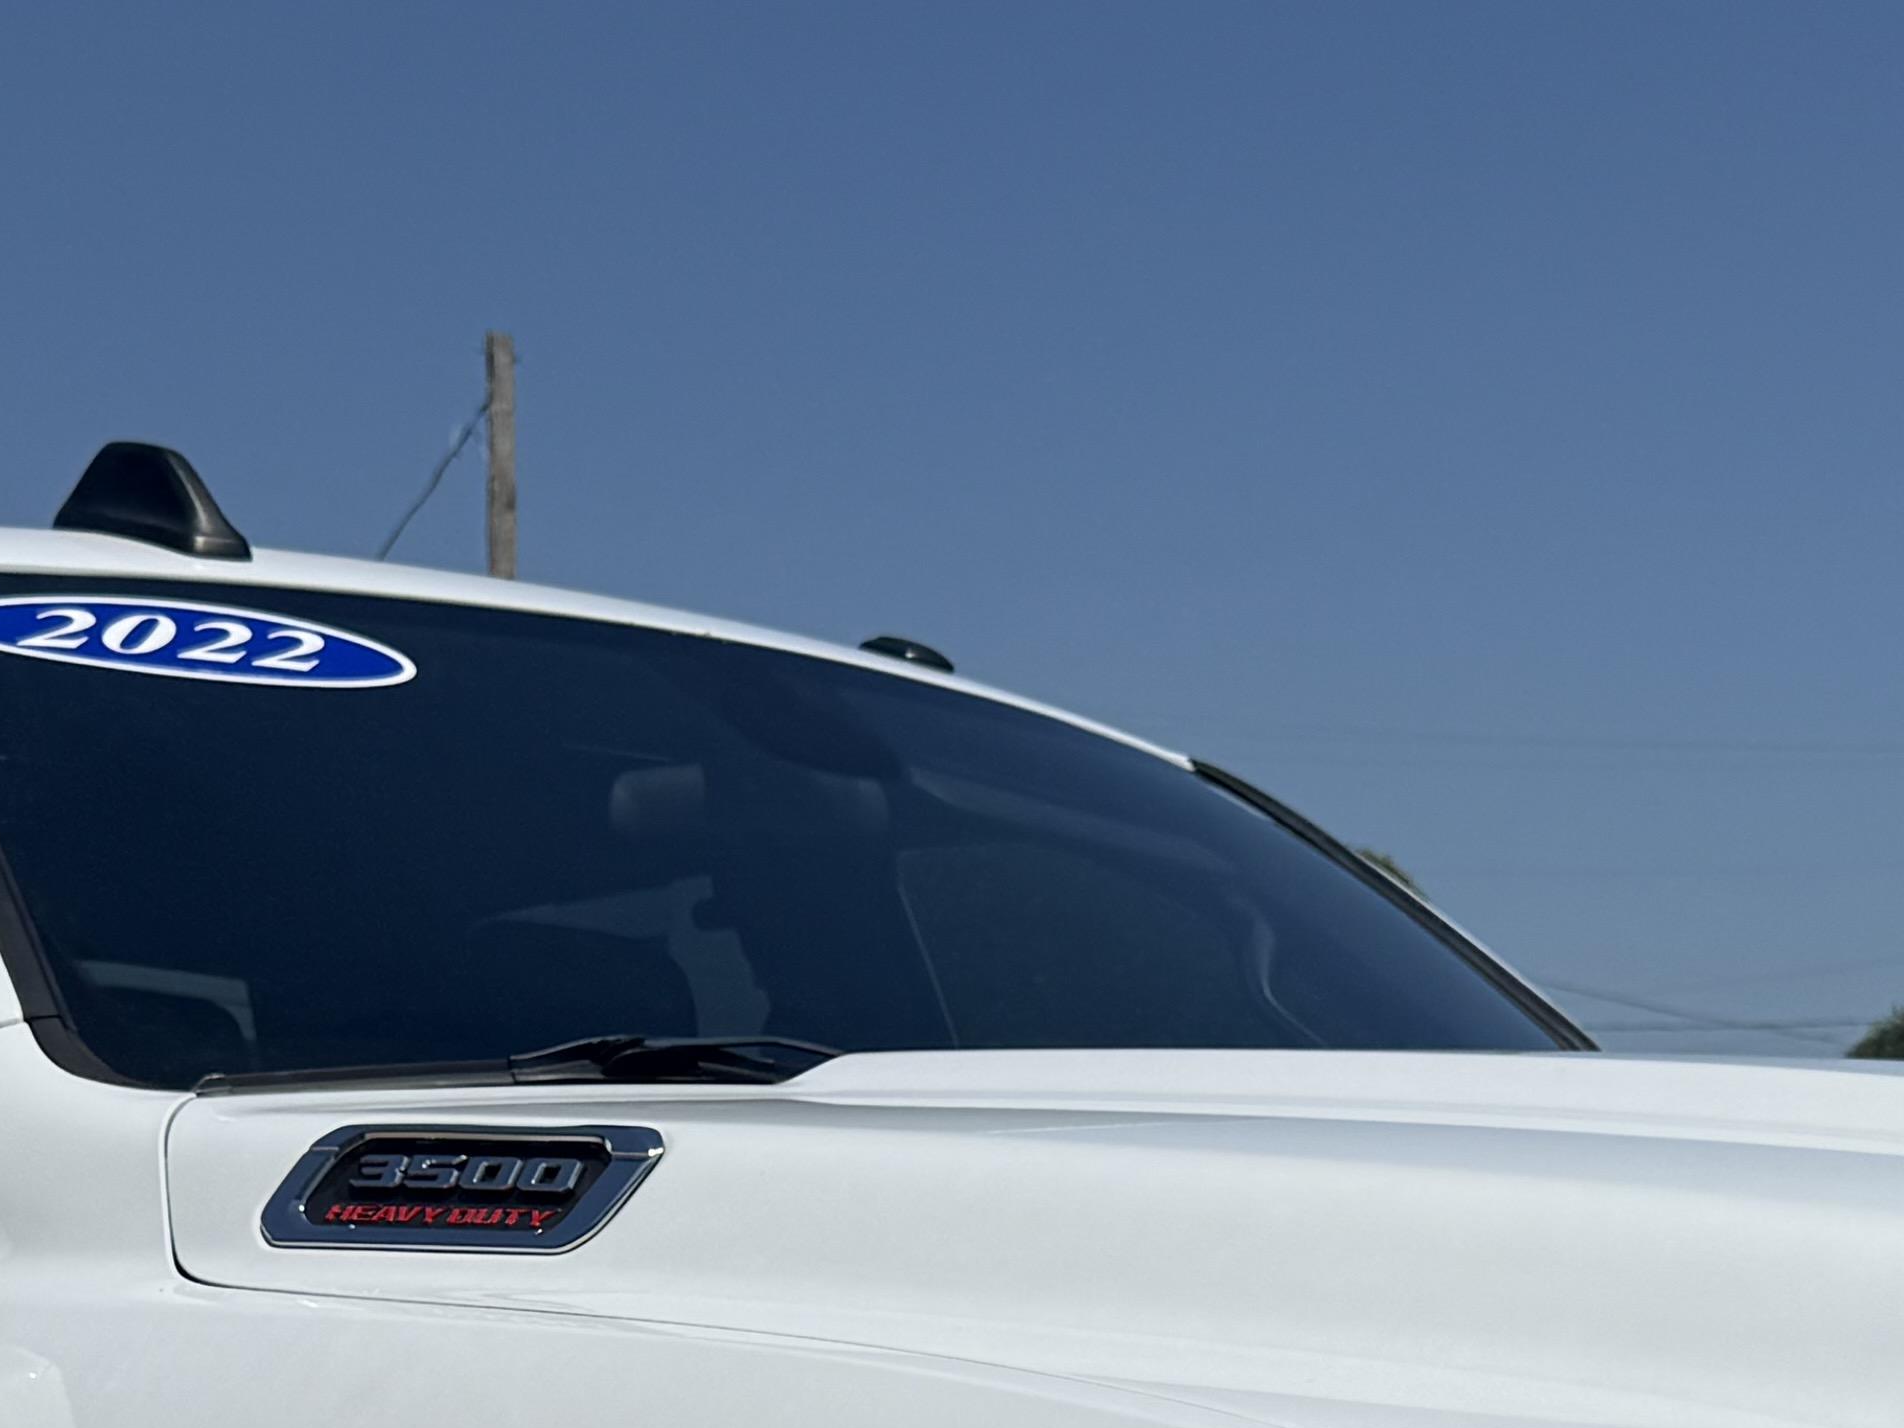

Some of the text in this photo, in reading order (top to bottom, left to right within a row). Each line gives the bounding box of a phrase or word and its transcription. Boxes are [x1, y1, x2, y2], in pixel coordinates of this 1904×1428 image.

[17, 607, 326, 672] 2022
[349, 1153, 587, 1194] 3500
[325, 1203, 557, 1226] HEAVY DUTY
